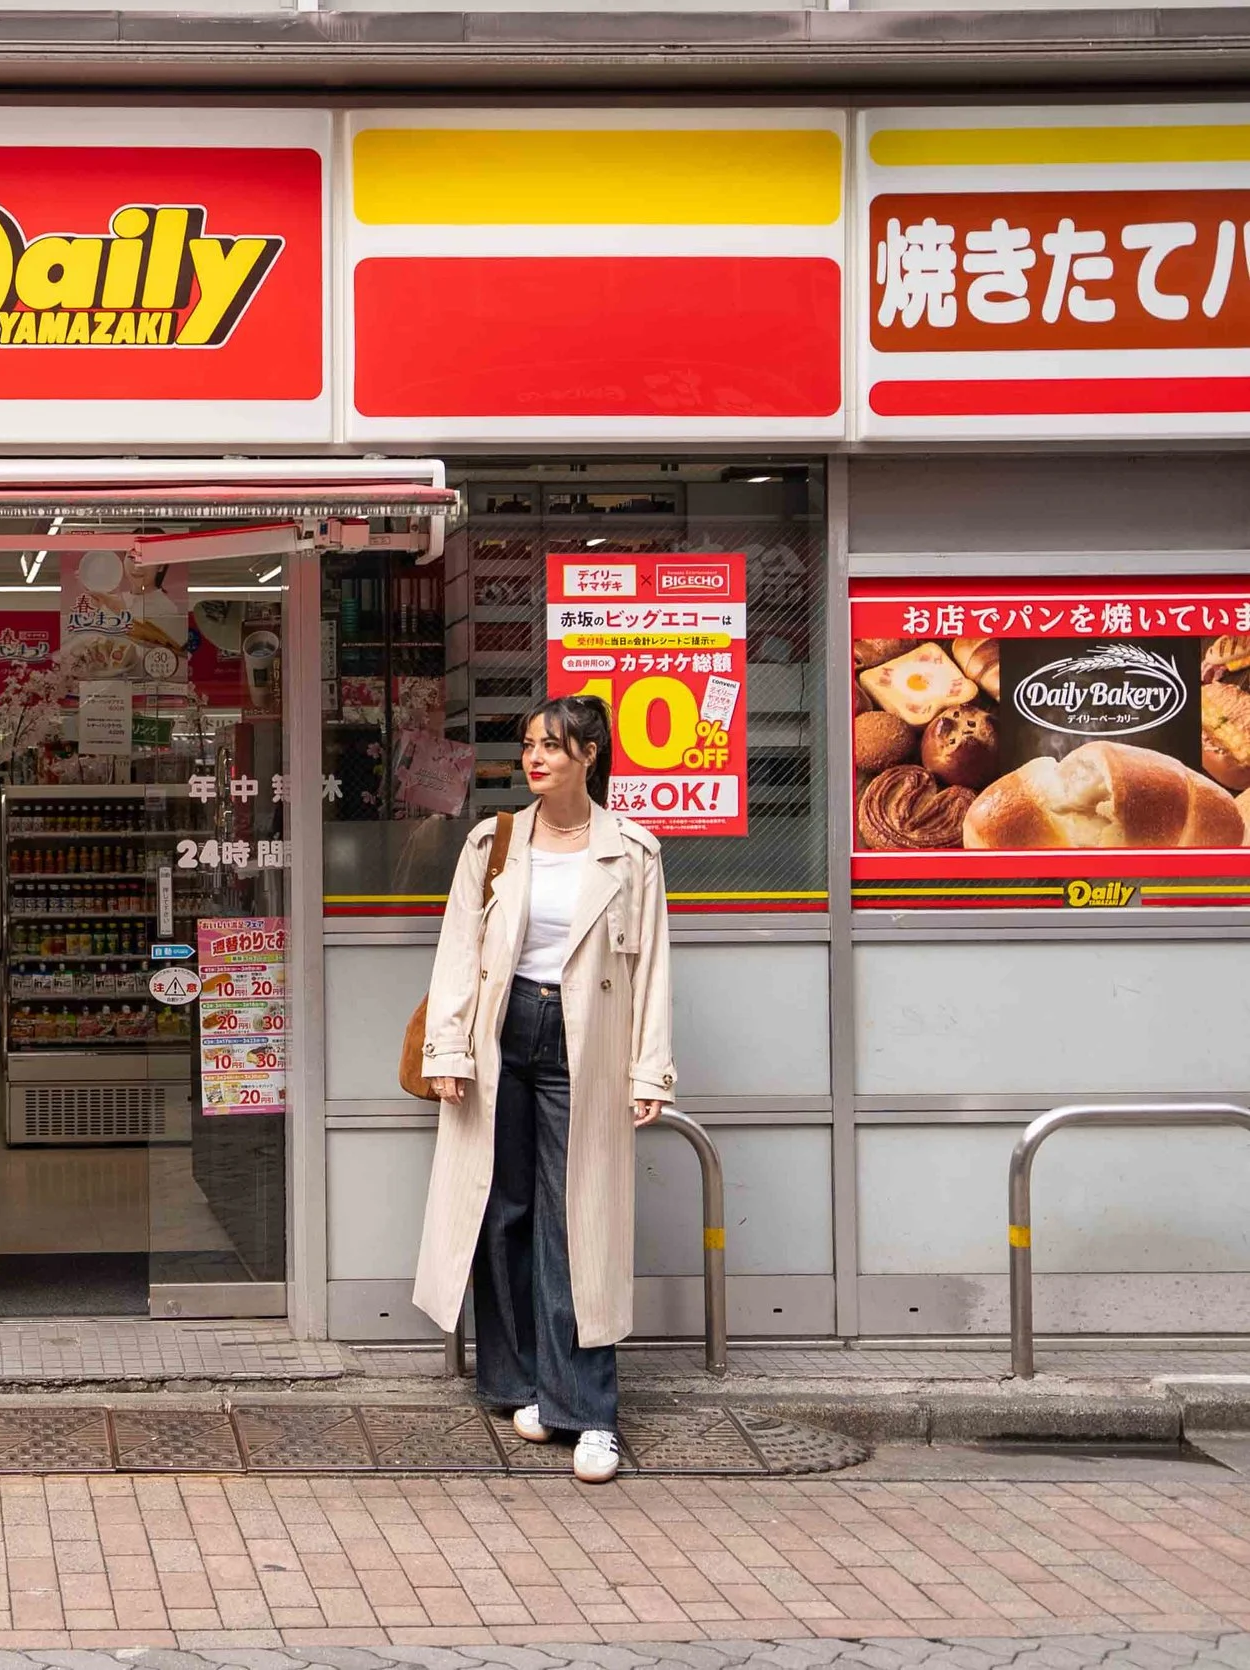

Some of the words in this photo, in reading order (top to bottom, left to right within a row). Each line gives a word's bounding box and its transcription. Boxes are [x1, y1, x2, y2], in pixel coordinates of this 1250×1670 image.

[0, 311, 175, 345] YAMAZAKI
[577, 570, 622, 579] デイリー
[662, 575, 687, 588] BIG
[688, 575, 724, 588] ECHO
[578, 581, 623, 591] ヤマザキ
[560, 609, 732, 629] 赤坂のビッグエコーは
[620, 653, 733, 673] カラオケ総額
[712, 679, 737, 689] conveni
[1026, 682, 1089, 712] Daily
[1090, 681, 1172, 712] Bakery
[1067, 714, 1140, 724] デイリーベーカリー
[684, 748, 729, 769] OFF
[612, 782, 648, 793] ドリンク
[651, 782, 721, 811] OK!
[1068, 880, 1135, 907] Daily
[153, 983, 164, 993] 注
[186, 983, 197, 993] 意
[240, 1089, 274, 1104] 20円引
